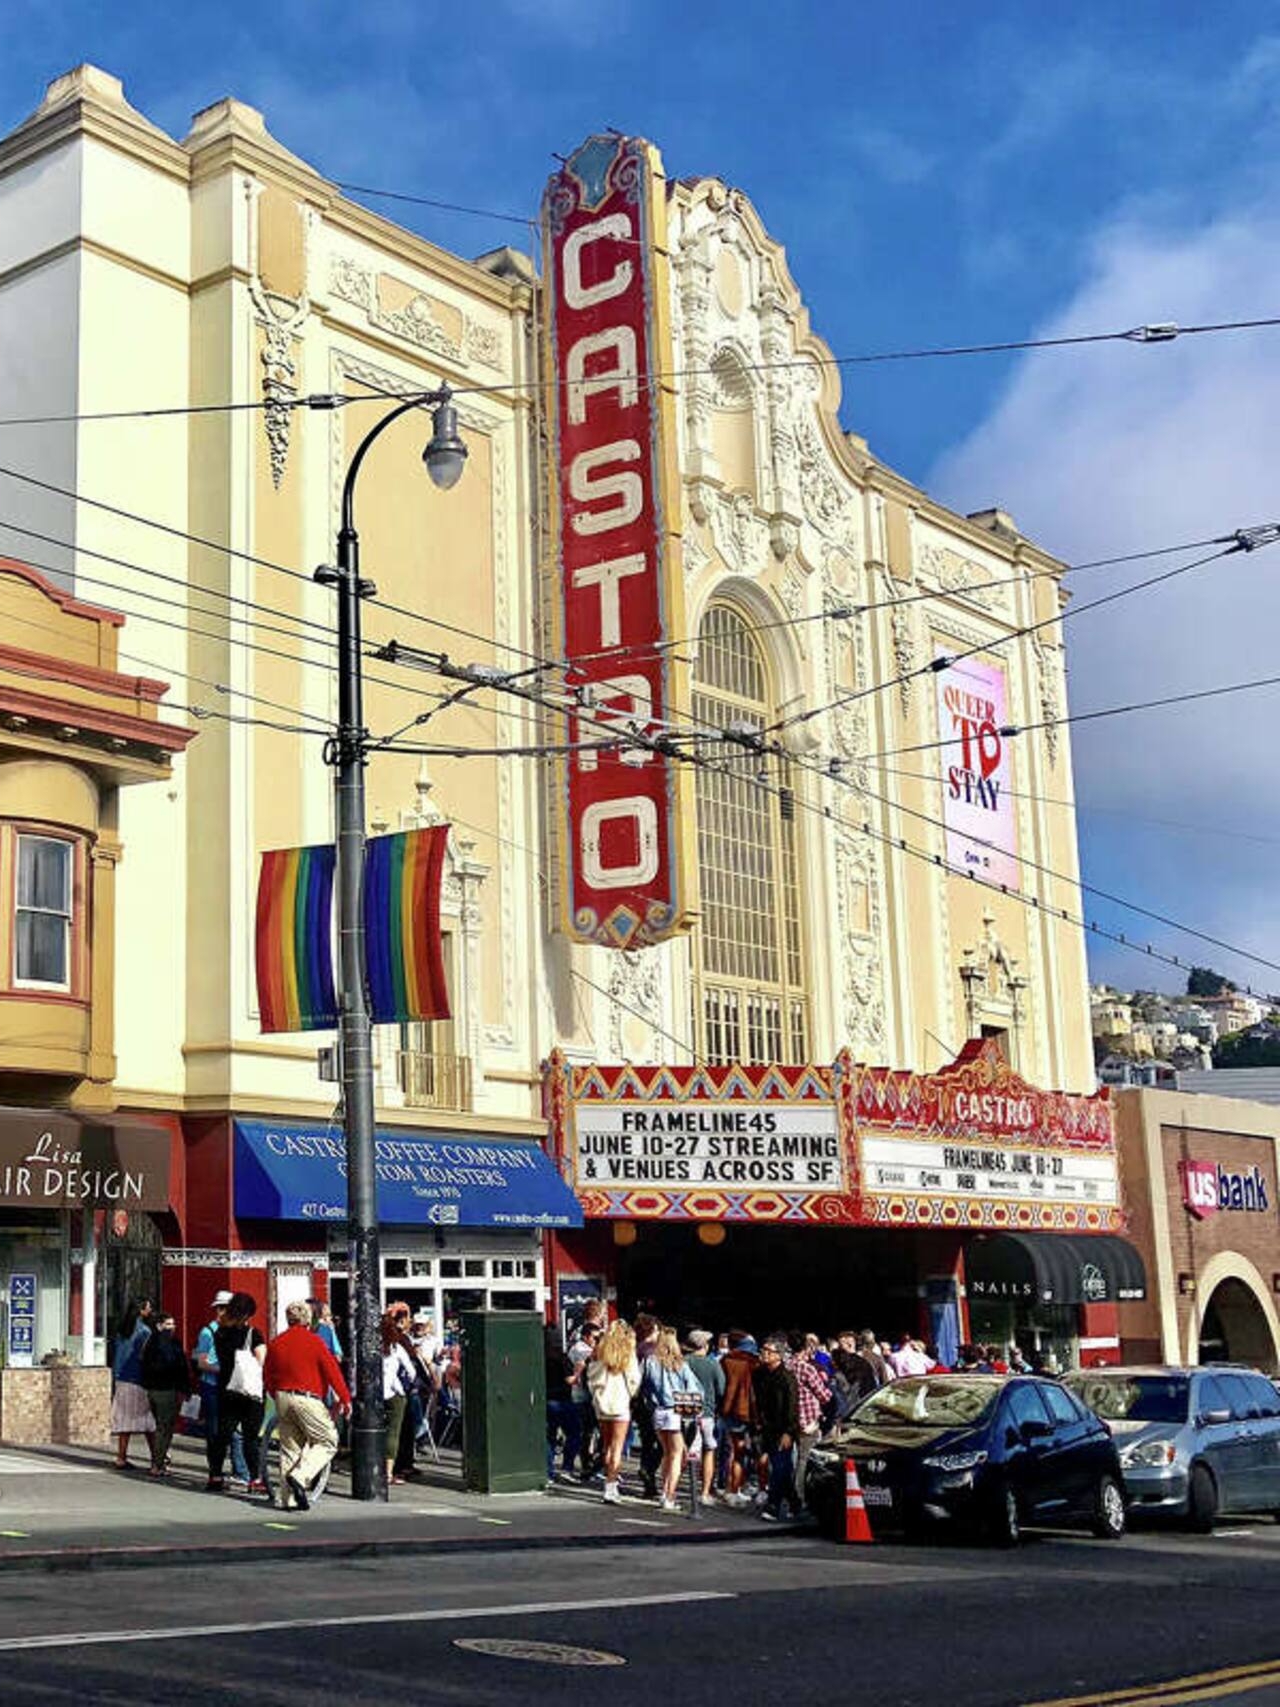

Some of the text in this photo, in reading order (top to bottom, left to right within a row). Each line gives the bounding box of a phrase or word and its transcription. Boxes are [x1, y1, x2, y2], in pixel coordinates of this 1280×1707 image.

[561, 213, 660, 890] CASTRO
[943, 685, 996, 724] QUEER
[952, 714, 1002, 781] TO
[948, 765, 1000, 812] STAY
[622, 1112, 778, 1133] FRAMELINE45
[955, 1091, 1034, 1128] CASTRO
[25, 1132, 83, 1164] Lisa
[375, 1140, 443, 1163] OFFEE
[441, 1145, 538, 1170] COMPANY
[580, 1135, 838, 1158] JUNE 10-27 STREAMING
[43, 1168, 144, 1200] DESIGN
[418, 1165, 508, 1187] ROASTERS
[585, 1158, 834, 1182] & VENUES ACROSS SF
[973, 1281, 1032, 1295] NAILS
